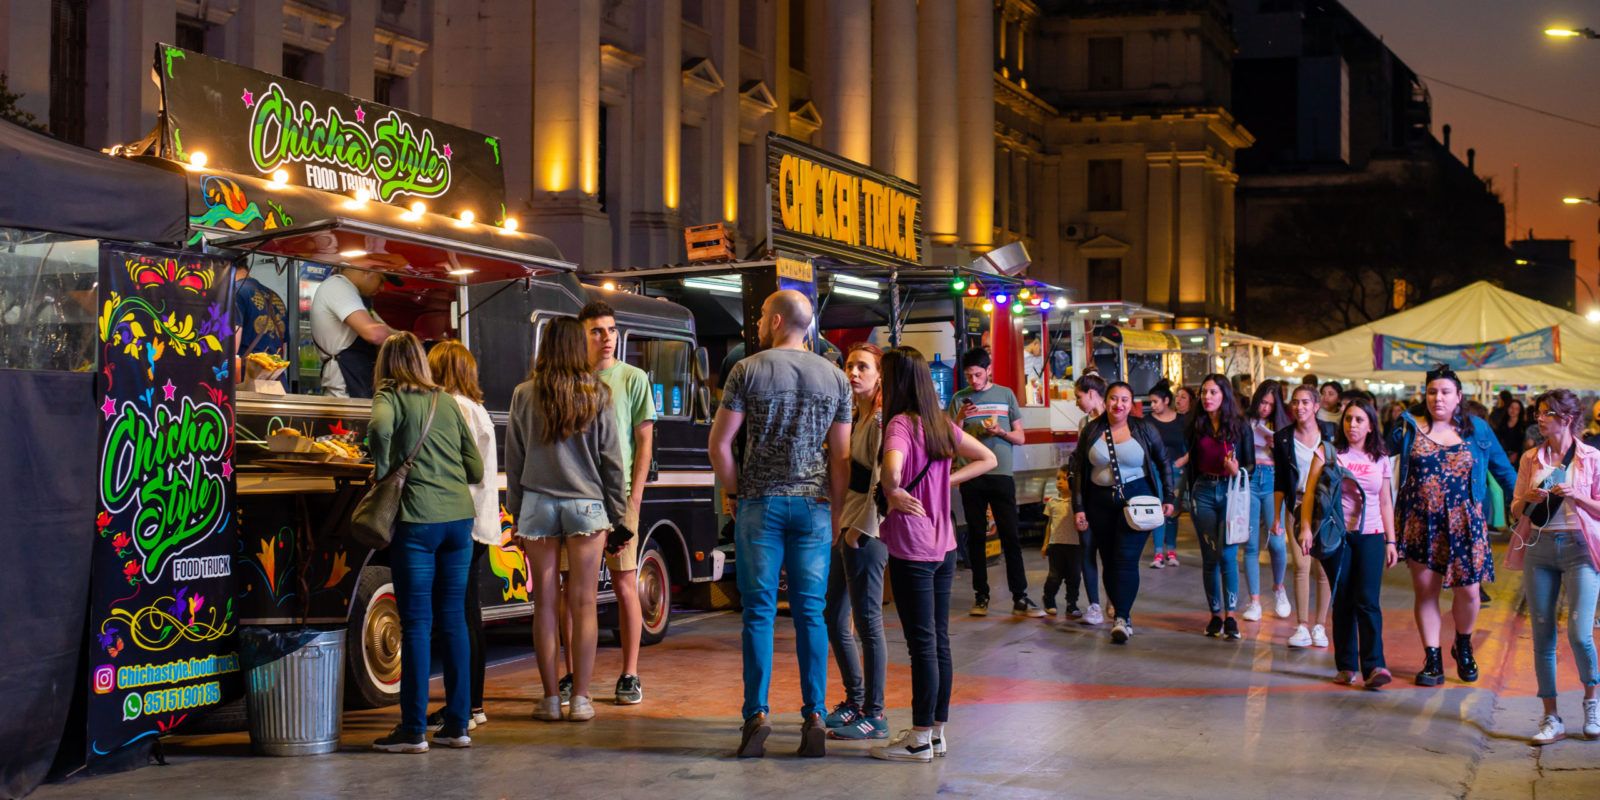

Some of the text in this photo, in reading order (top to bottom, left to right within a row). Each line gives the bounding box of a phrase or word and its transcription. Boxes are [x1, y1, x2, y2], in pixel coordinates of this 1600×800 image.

[251, 86, 449, 201] Chicha Style
[305, 163, 379, 201] FOOD TRUCK
[779, 153, 918, 263] CHICKEN TRUCK
[102, 399, 225, 510] Chicha
[1347, 462, 1371, 473] NIKE
[134, 457, 223, 580] Style
[173, 554, 231, 581] FOOD TRUCK
[117, 652, 240, 689] Chichastyle.foodtruck
[143, 681, 221, 715] 3515190185
